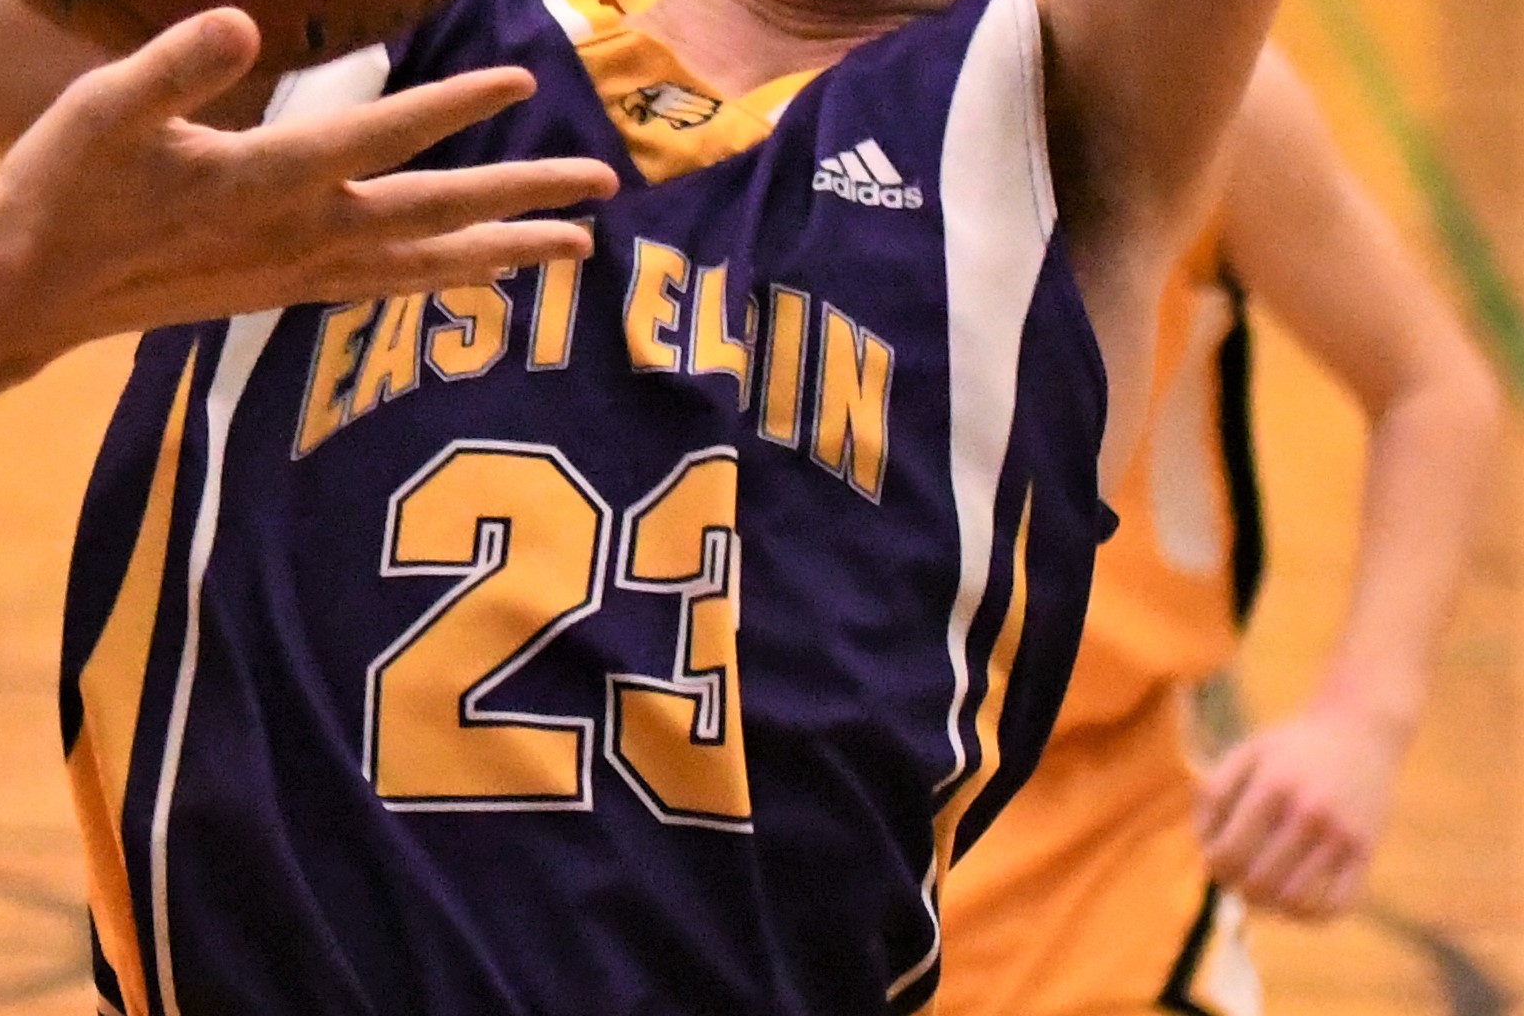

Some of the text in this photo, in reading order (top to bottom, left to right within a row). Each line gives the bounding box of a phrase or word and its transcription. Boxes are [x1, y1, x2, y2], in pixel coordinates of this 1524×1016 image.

[812, 170, 924, 210] adidas
[290, 217, 895, 506] EAST ELIN
[362, 438, 755, 834] 23
